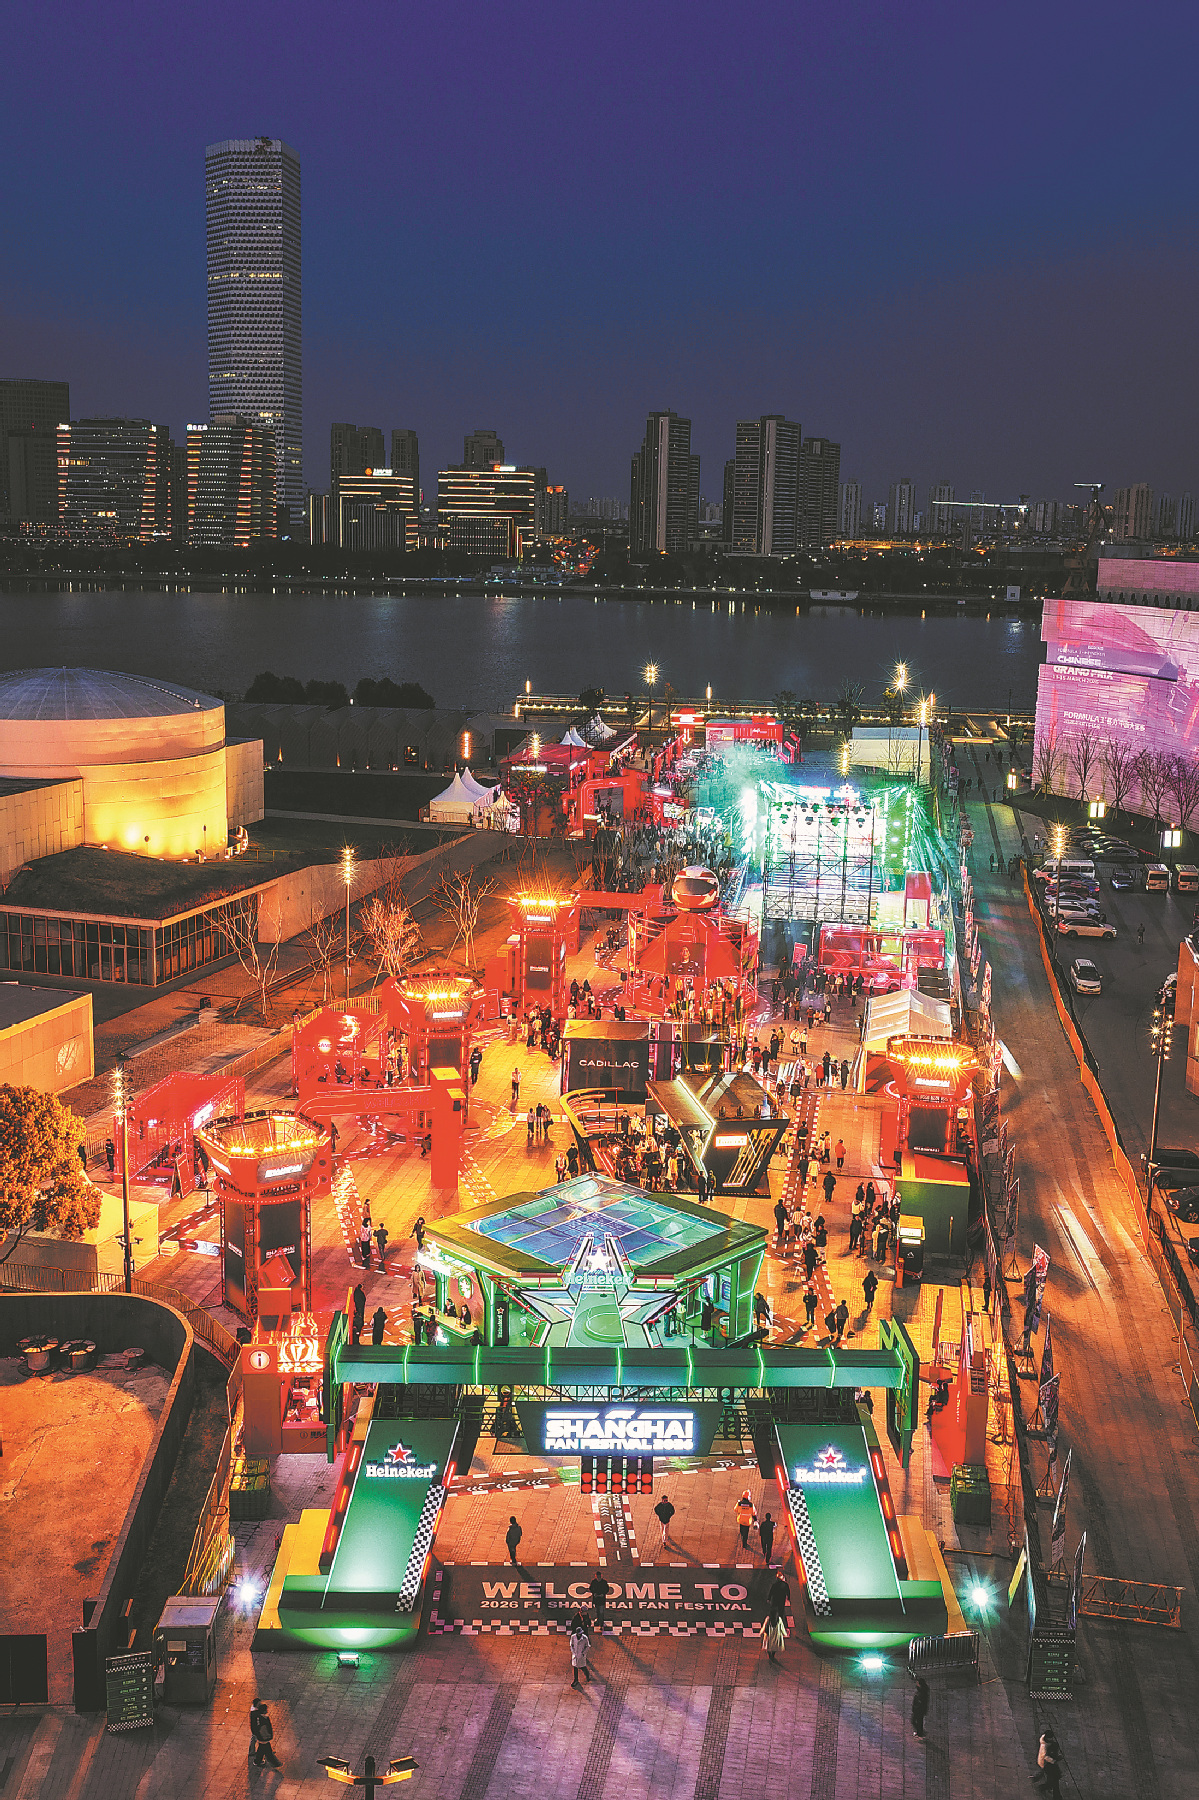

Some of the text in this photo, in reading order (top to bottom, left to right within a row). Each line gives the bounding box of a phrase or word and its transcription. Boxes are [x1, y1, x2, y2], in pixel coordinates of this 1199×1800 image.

[1057, 655, 1102, 667] CHINESE
[1053, 665, 1114, 680] GRAND PRIX
[1063, 711, 1100, 723] FORMULA
[579, 1060, 640, 1069] CADILLAC
[564, 1271, 631, 1285] Heineken
[545, 1419, 694, 1439] SHANGHAI
[544, 1438, 694, 1450] FAN FESTIVAL 2026
[366, 1464, 434, 1479] Heineken
[795, 1468, 864, 1483] Heineken
[694, 1583, 748, 1601] TO
[480, 1601, 752, 1611] 2026 F1 SHANHAI FAN FESTIVAL
